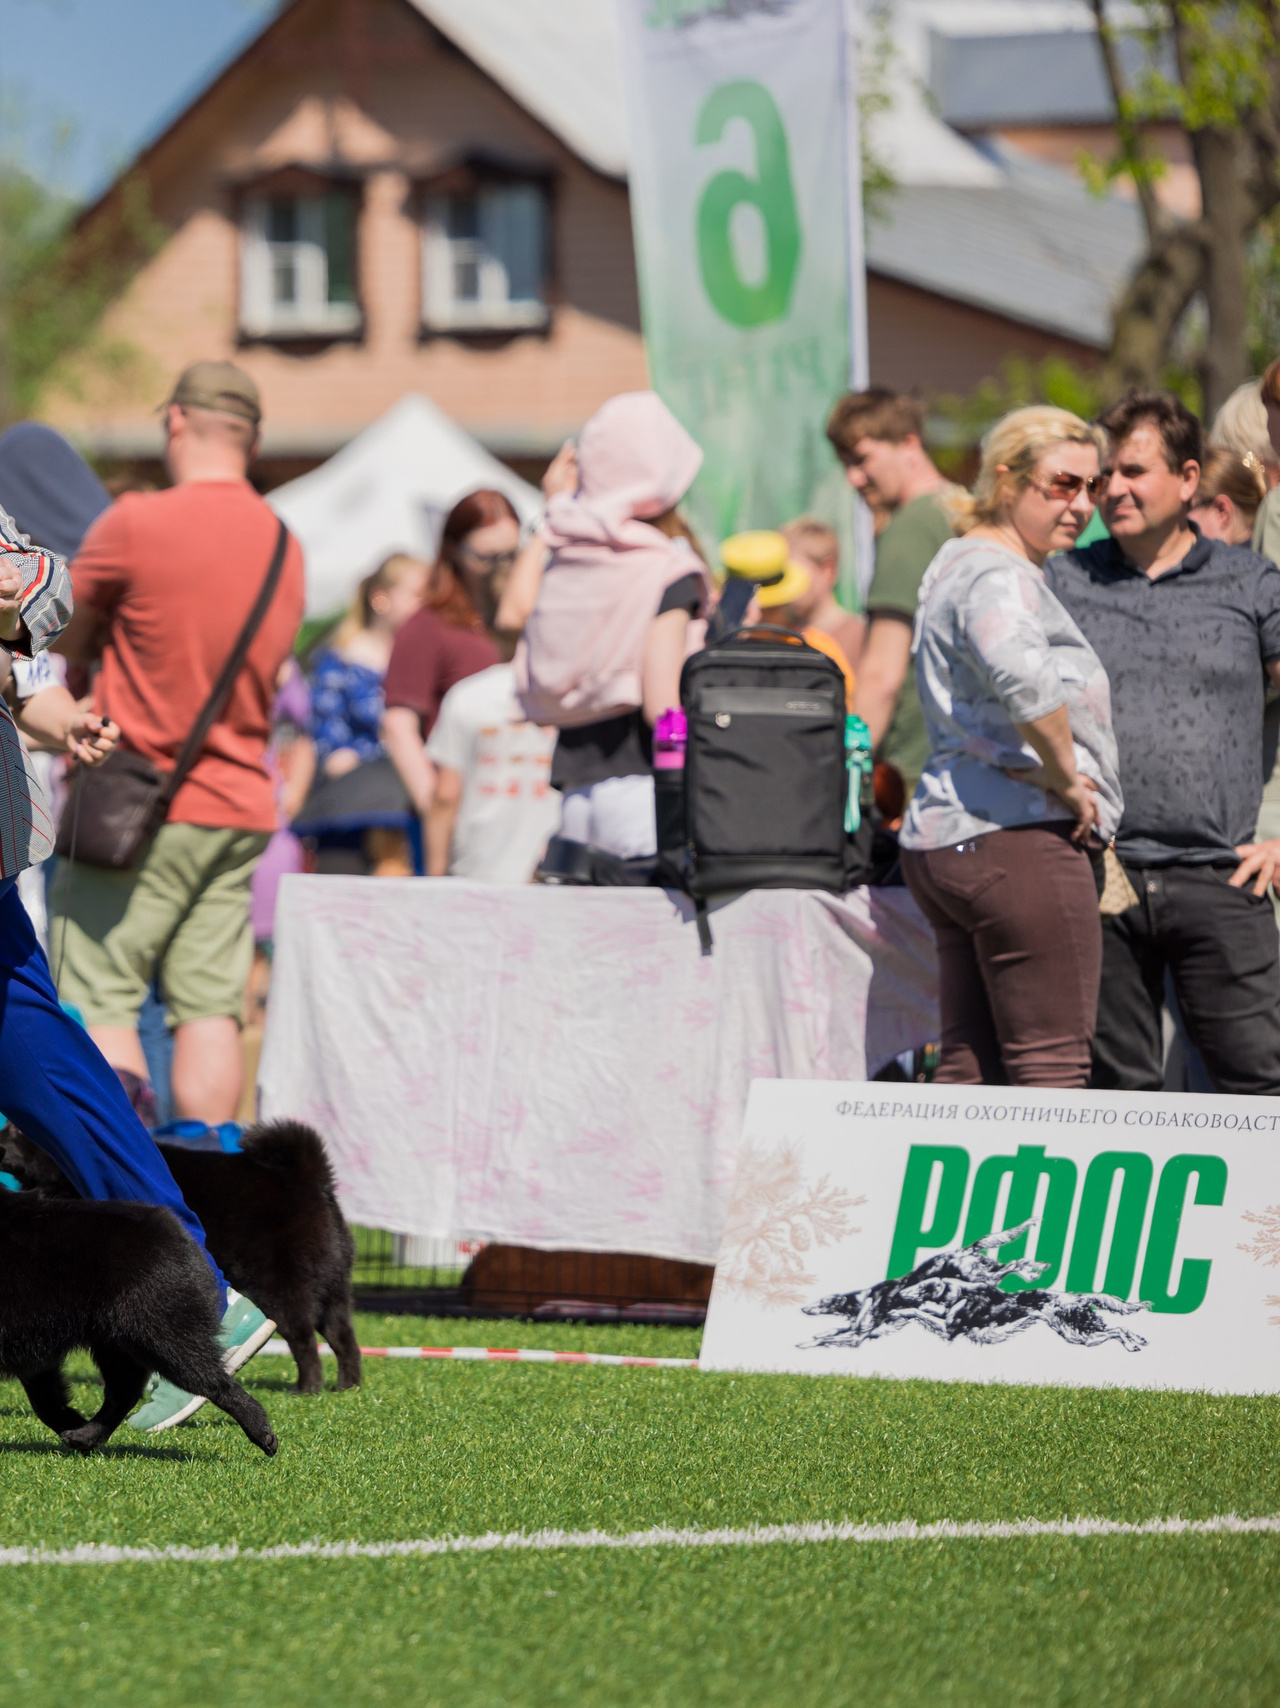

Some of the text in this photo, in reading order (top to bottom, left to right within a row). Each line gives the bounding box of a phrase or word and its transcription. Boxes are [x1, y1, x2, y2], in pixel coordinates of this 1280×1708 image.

[836, 1099, 1280, 1132] ФЕДЕРАЦИЯ ОХОТНИЧЬЕГО СОБАКОВОДСТ
[886, 1143, 1228, 1314] РФОС
